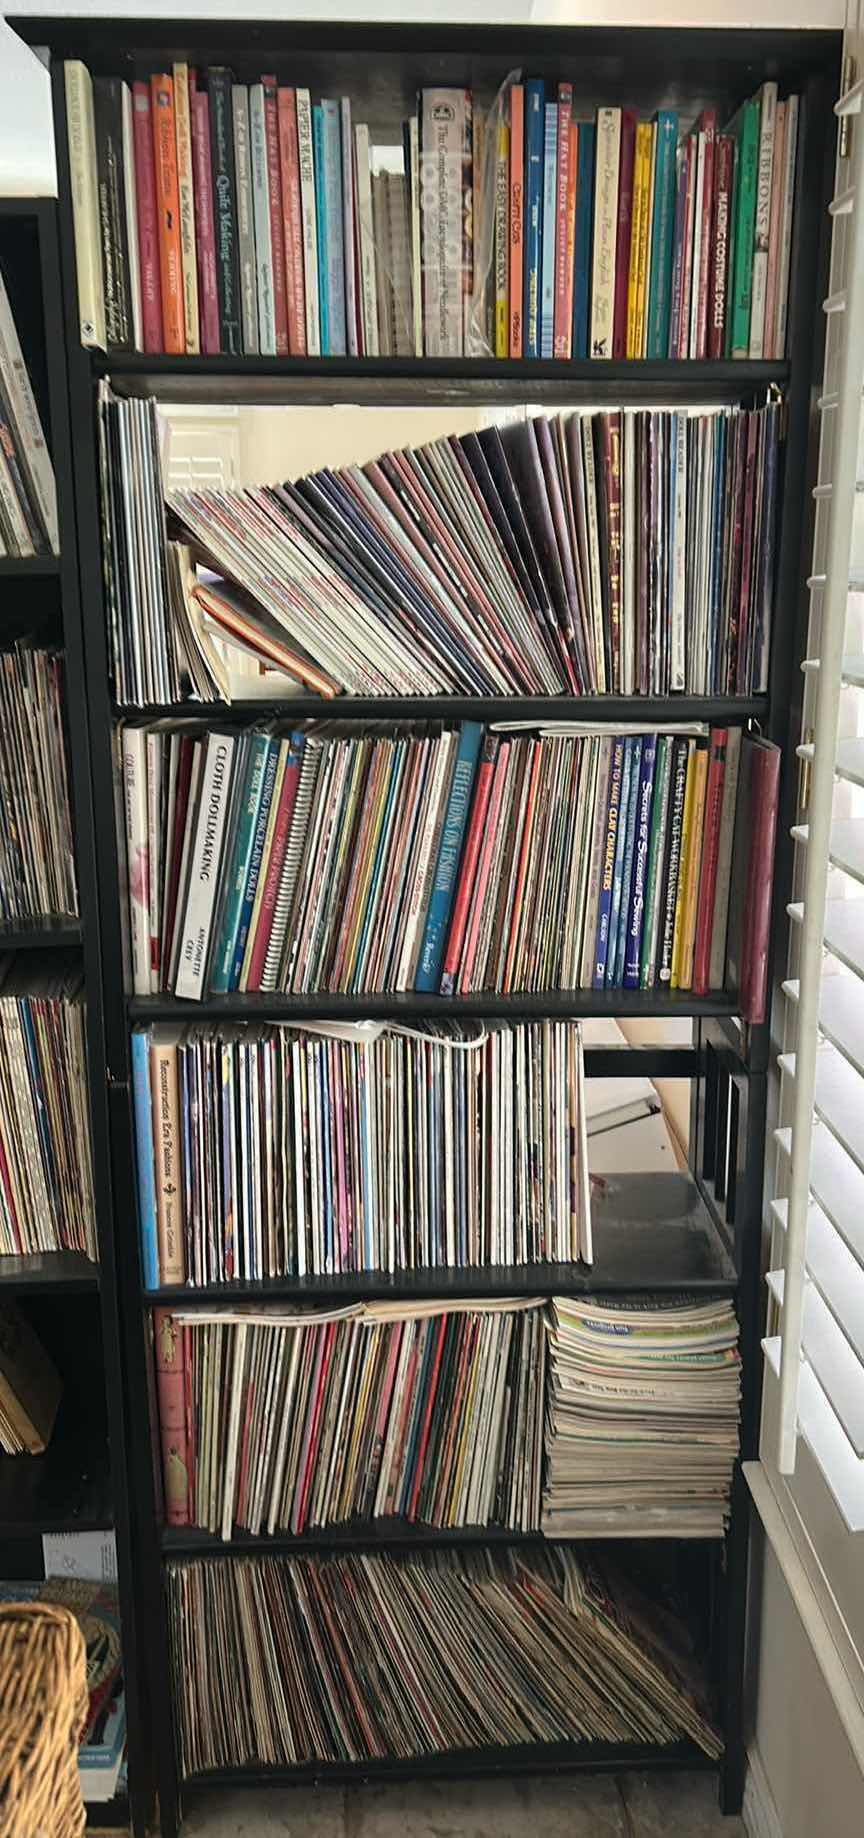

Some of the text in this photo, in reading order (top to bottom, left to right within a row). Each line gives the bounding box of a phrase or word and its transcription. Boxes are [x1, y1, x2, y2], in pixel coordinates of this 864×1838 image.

[560, 110, 569, 136] THE
[497, 160, 507, 181] THE
[560, 141, 569, 169] HAT
[759, 131, 773, 226] RIBBONS
[216, 175, 231, 210] Quilt
[497, 183, 507, 209] EASY
[560, 173, 569, 211] BOOK
[716, 192, 728, 240] MAKING
[219, 212, 233, 261] Making
[714, 241, 726, 291] COSTUME
[713, 294, 725, 329] DOLLS
[262, 752, 278, 805] DRESSING
[445, 760, 473, 829] REFLECTIONS
[199, 745, 228, 881] CLOTH DOLLMAKING
[251, 807, 270, 865] PORCELAIN
[603, 744, 623, 890] HOW TO MAKE CLAY CHARACTERS
[443, 830, 462, 846] ON
[631, 780, 652, 936] Secrets for Successful Sewing
[245, 868, 259, 902] DOLLS
[160, 1059, 173, 1178] Reconstruction Era Fashions
